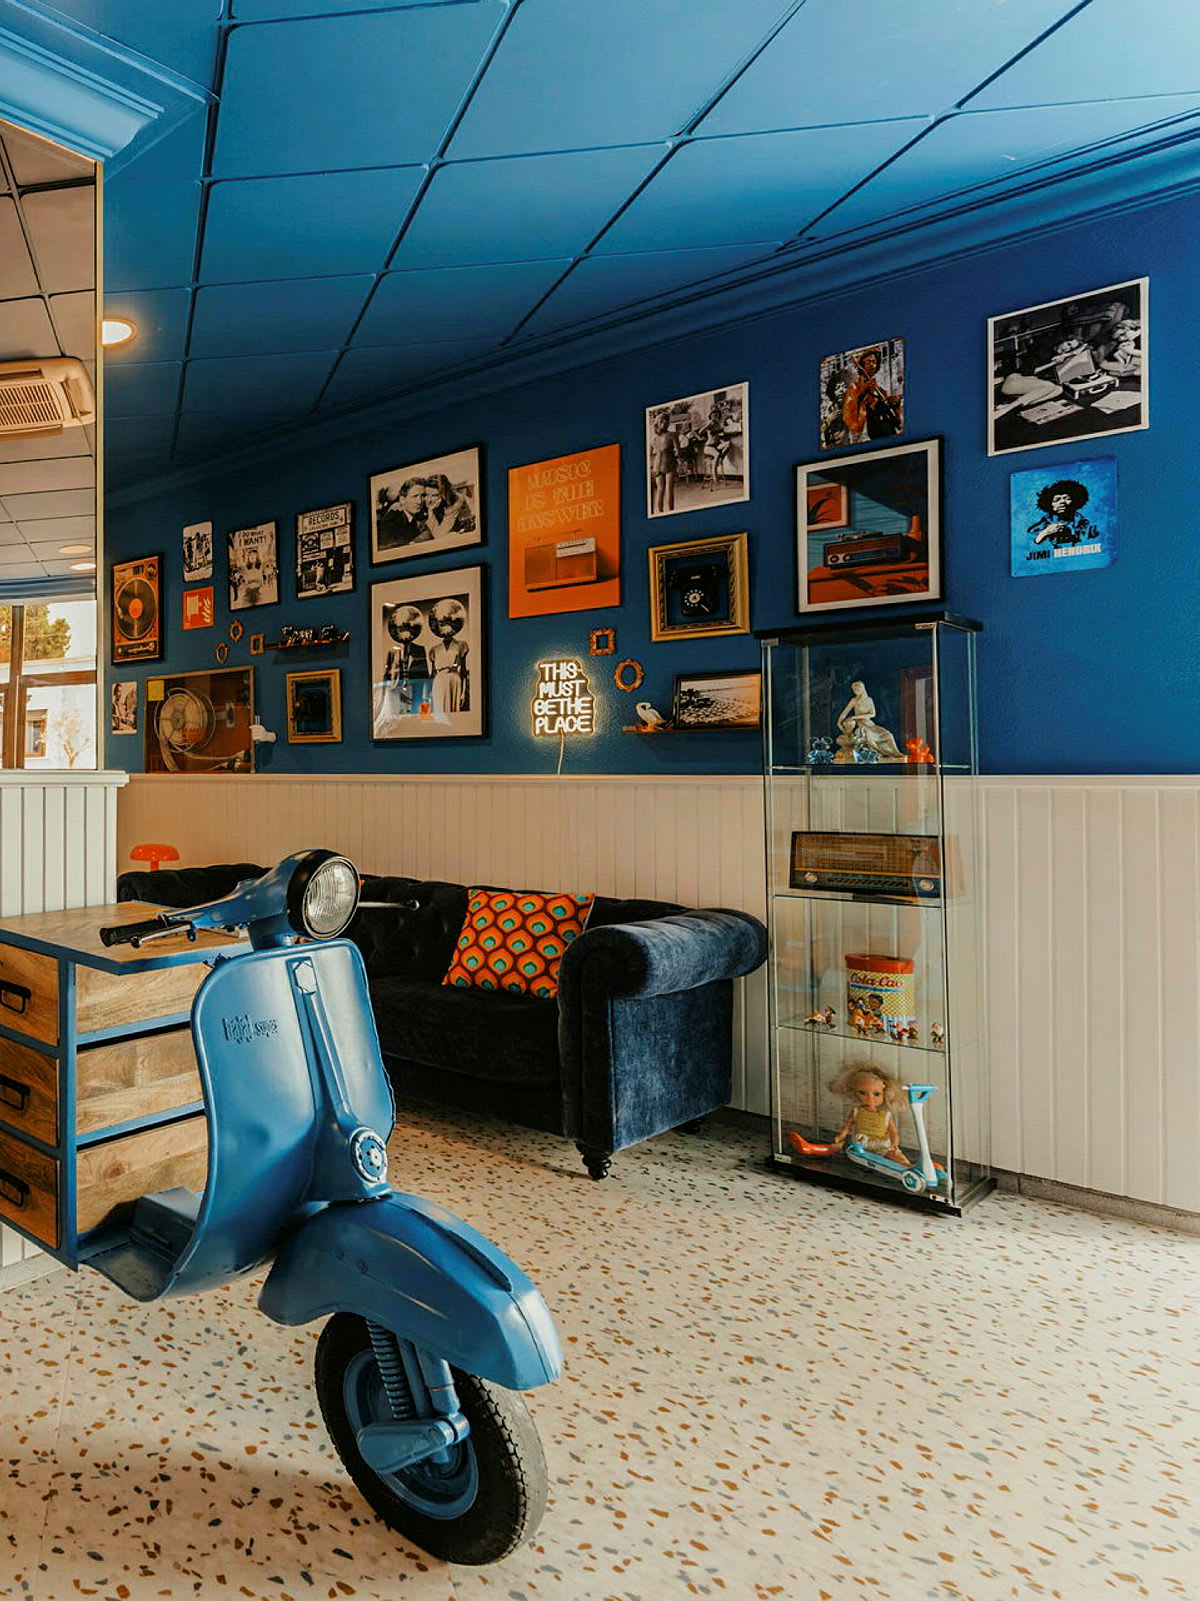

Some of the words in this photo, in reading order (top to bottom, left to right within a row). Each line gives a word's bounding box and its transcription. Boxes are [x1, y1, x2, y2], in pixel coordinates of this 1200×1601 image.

[527, 460, 592, 490] MUSIC
[525, 491, 546, 511] IS
[553, 480, 594, 504] THE
[517, 500, 604, 533] ANSWER
[1026, 549, 1050, 561] JIMI
[540, 662, 578, 681] THIS
[540, 680, 586, 699] MUST
[534, 698, 557, 715] BE
[557, 697, 592, 715] THE
[535, 715, 592, 735] PLACE
